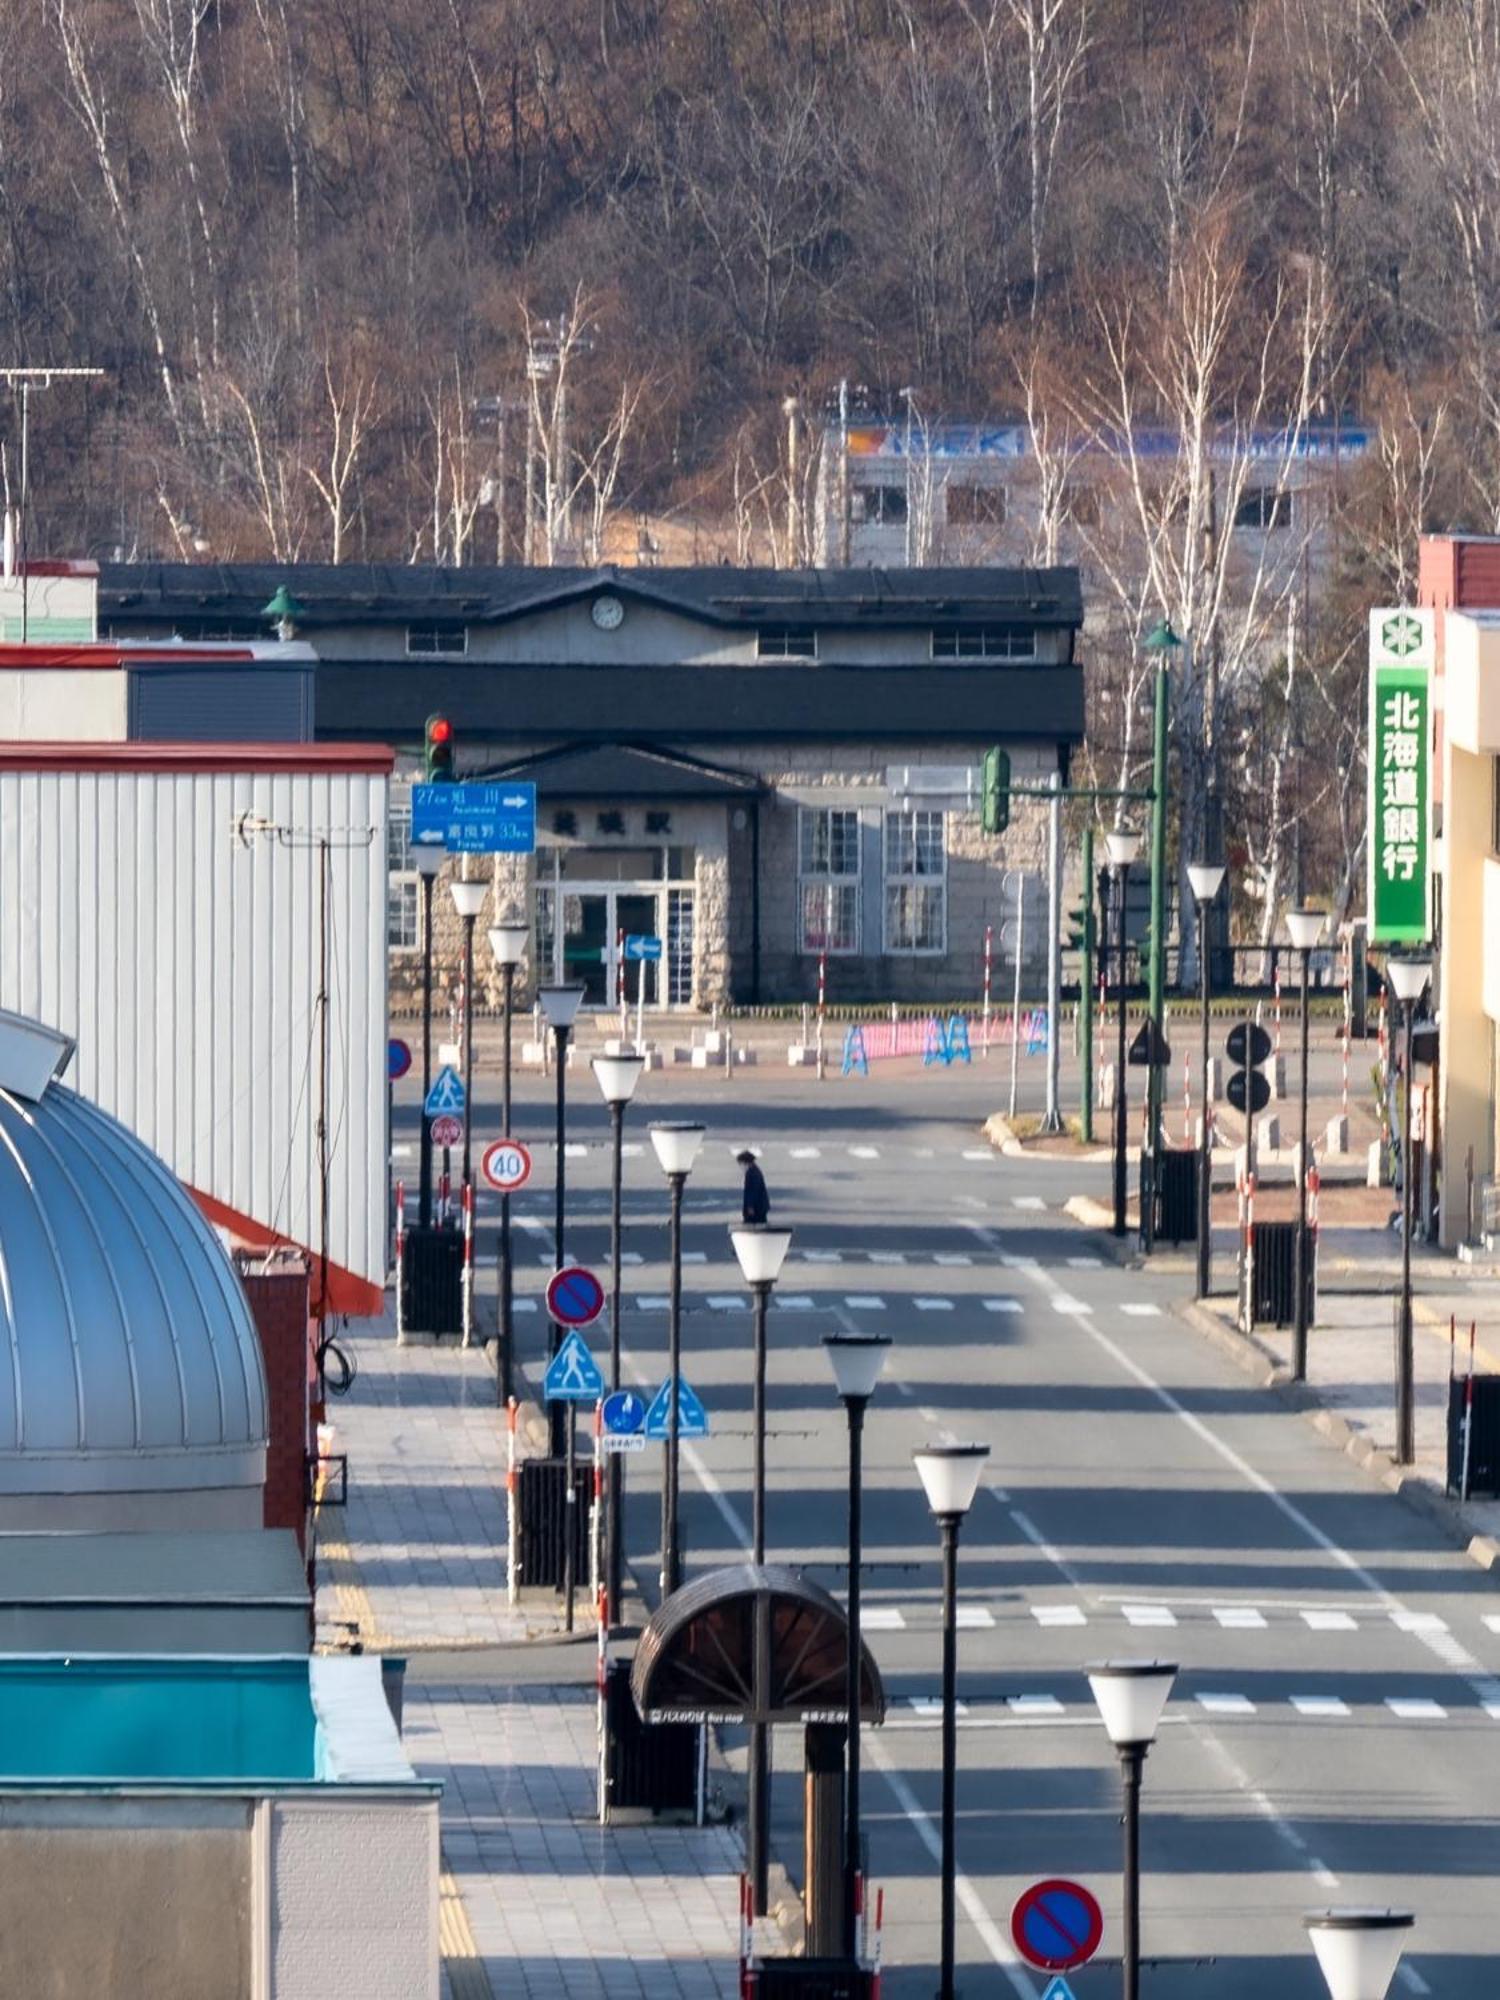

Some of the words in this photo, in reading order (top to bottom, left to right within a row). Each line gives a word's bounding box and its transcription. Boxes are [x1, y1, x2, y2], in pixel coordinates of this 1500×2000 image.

[1383, 691, 1419, 880] 北海道銀行
[493, 1153, 520, 1177] 40
